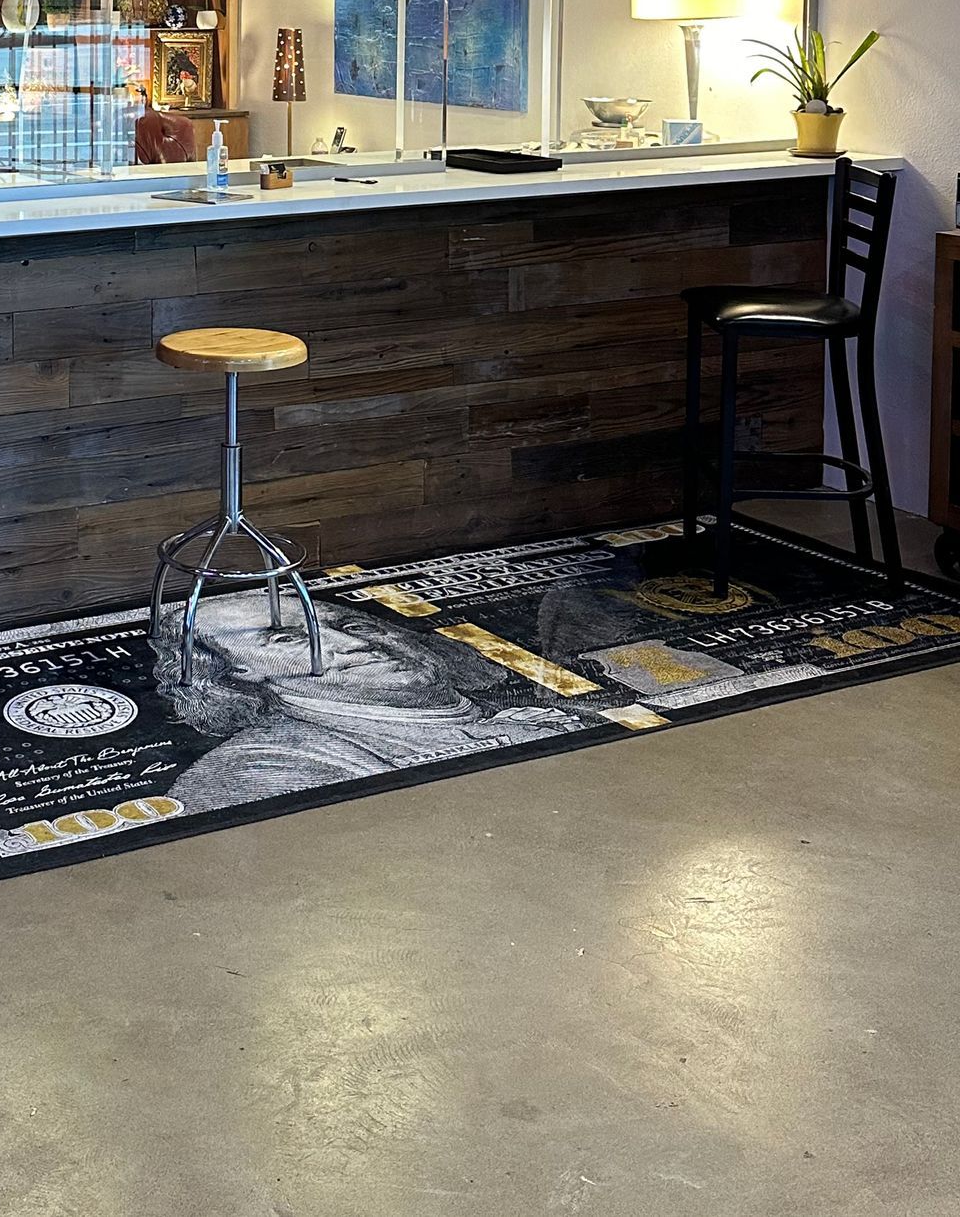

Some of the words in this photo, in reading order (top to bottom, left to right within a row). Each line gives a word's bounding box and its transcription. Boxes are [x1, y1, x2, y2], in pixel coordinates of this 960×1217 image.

[85, 628, 147, 645] NOTE
[411, 738, 495, 761] FRANKLIN
[14, 773, 61, 788] Secretary
[62, 770, 74, 779] of
[74, 767, 90, 775] the
[5, 799, 55, 814] Treasurer
[57, 796, 68, 806] of
[70, 792, 85, 801] the
[86, 784, 122, 797] United
[22, 795, 185, 846] 100
